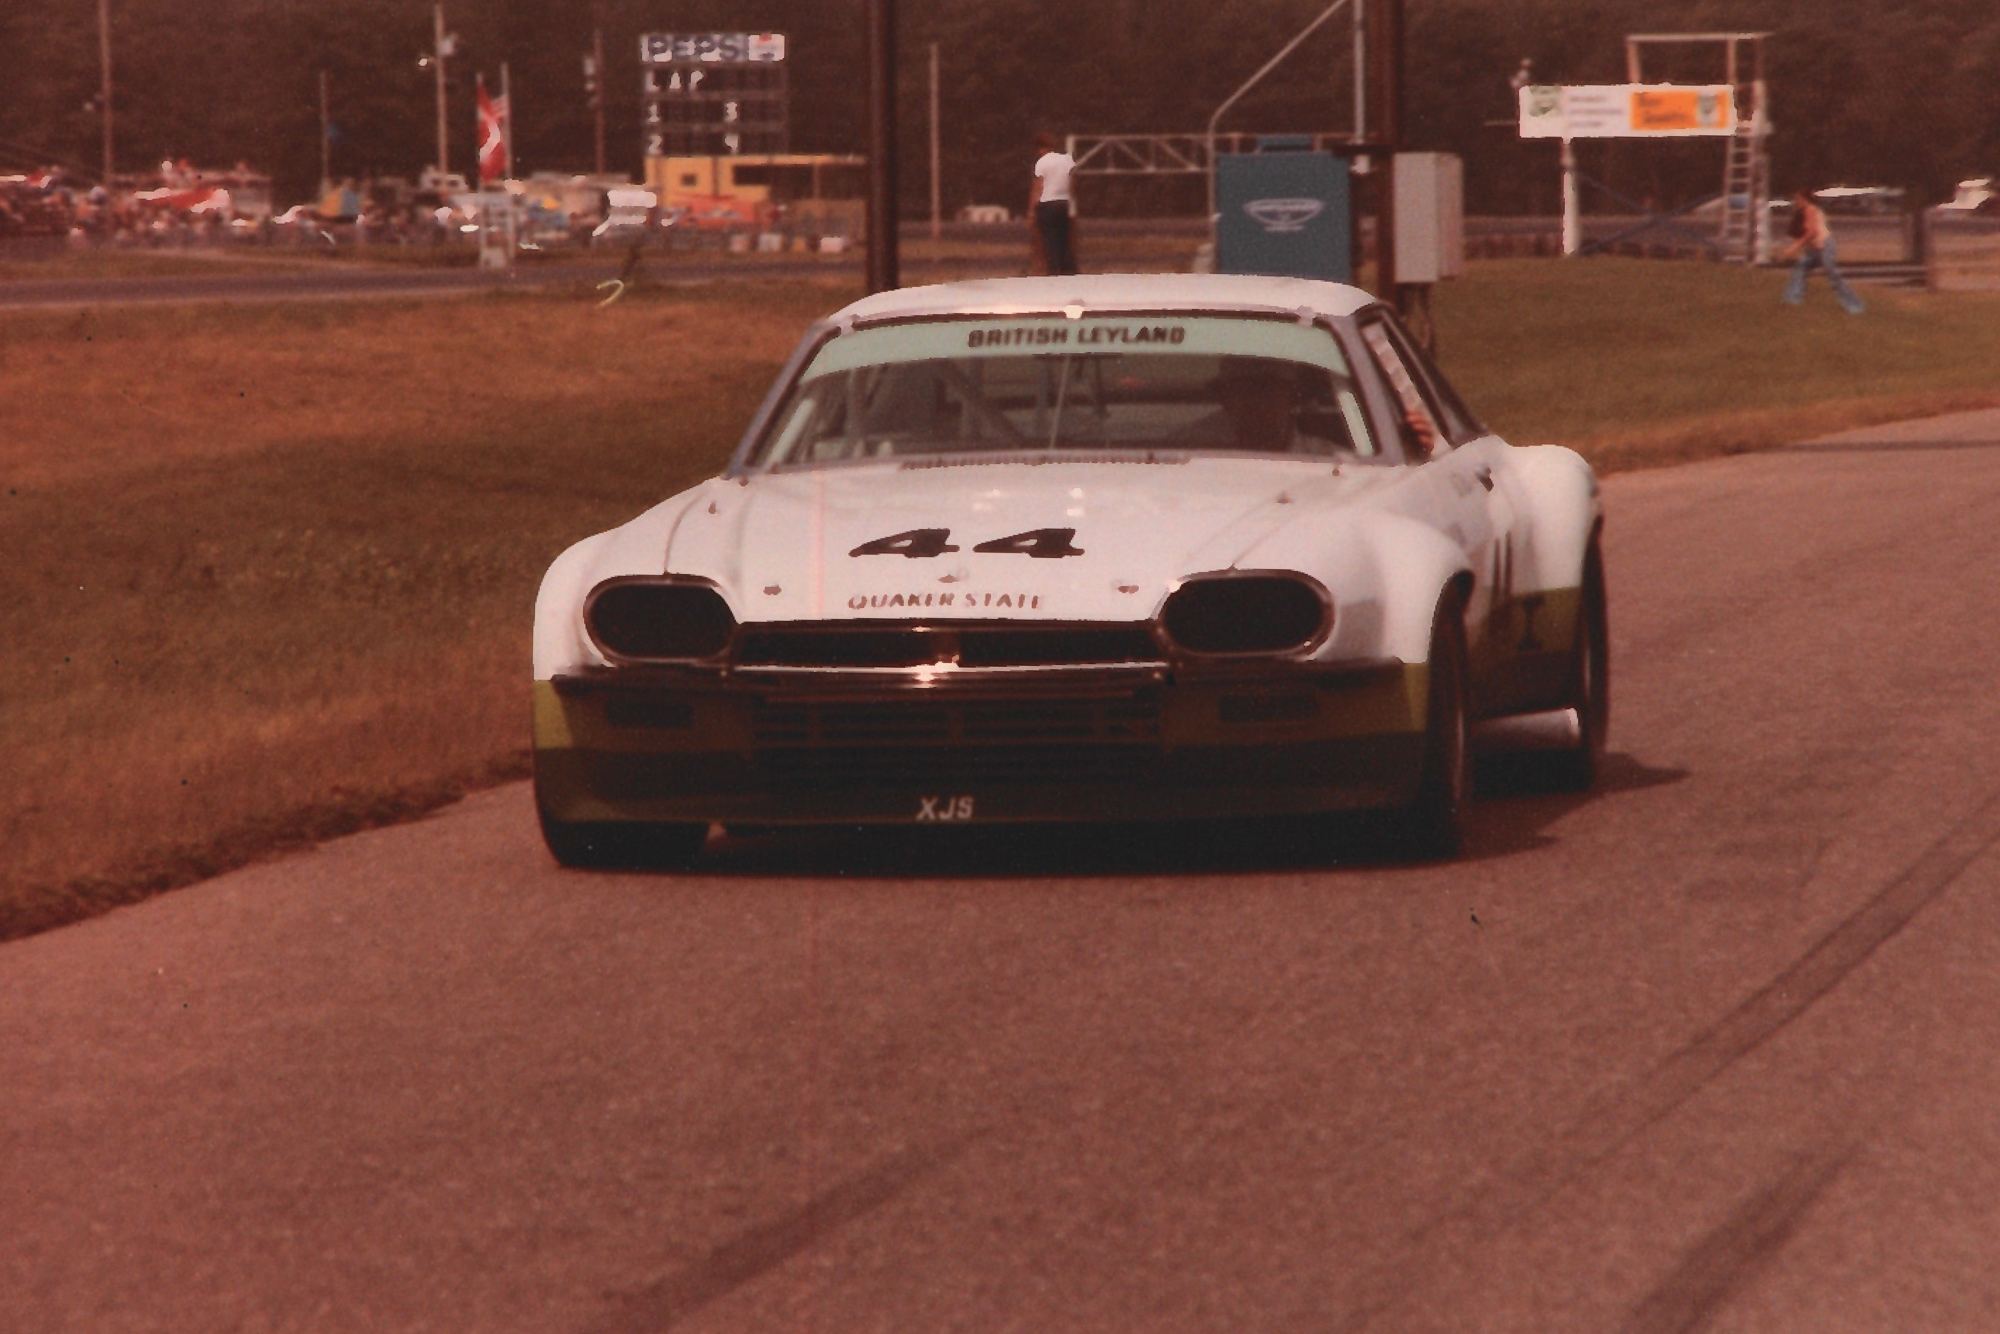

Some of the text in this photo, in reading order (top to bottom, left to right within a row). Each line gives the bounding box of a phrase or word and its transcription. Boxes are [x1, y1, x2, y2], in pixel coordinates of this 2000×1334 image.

[645, 69, 705, 91] LAP
[648, 103, 660, 123] 1
[648, 134, 663, 155] 2
[968, 325, 1185, 347] BRITISH LEYLAND
[848, 528, 1085, 558] 44
[915, 796, 975, 820] XJS
